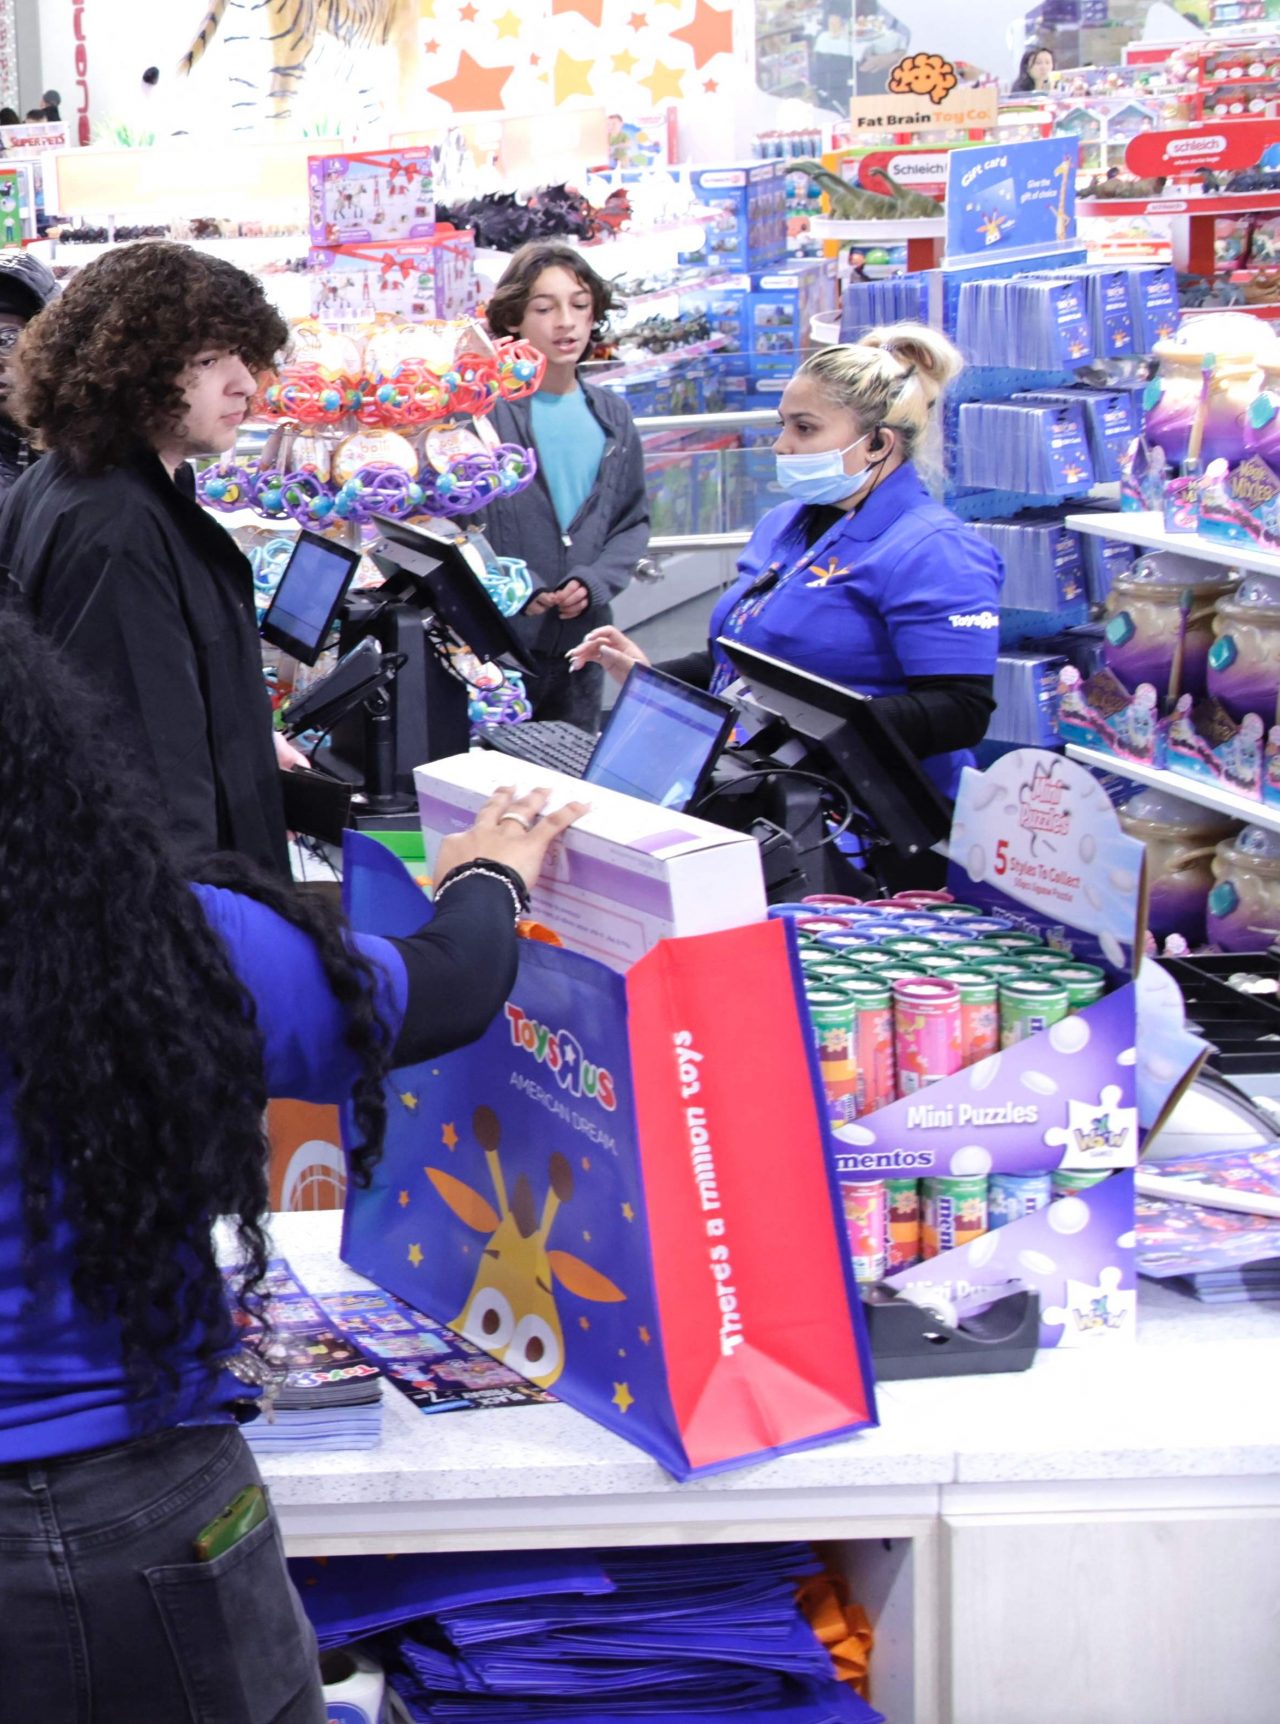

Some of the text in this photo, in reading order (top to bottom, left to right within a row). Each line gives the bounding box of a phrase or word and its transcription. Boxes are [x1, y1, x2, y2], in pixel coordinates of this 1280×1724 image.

[857, 116, 883, 128] Fat
[886, 112, 932, 126] Brain
[934, 110, 965, 124] Toy
[893, 162, 944, 176] Schleich
[960, 155, 1009, 188] Gift card
[993, 839, 1010, 876] 5
[1010, 857, 1037, 878] Styles
[673, 1029, 705, 1100] toys
[510, 1071, 570, 1123] AMERICAN
[907, 1102, 1039, 1130] Mini Puzzles
[685, 1106, 722, 1211] million
[835, 1150, 934, 1172] mentos
[706, 1217, 726, 1237] a
